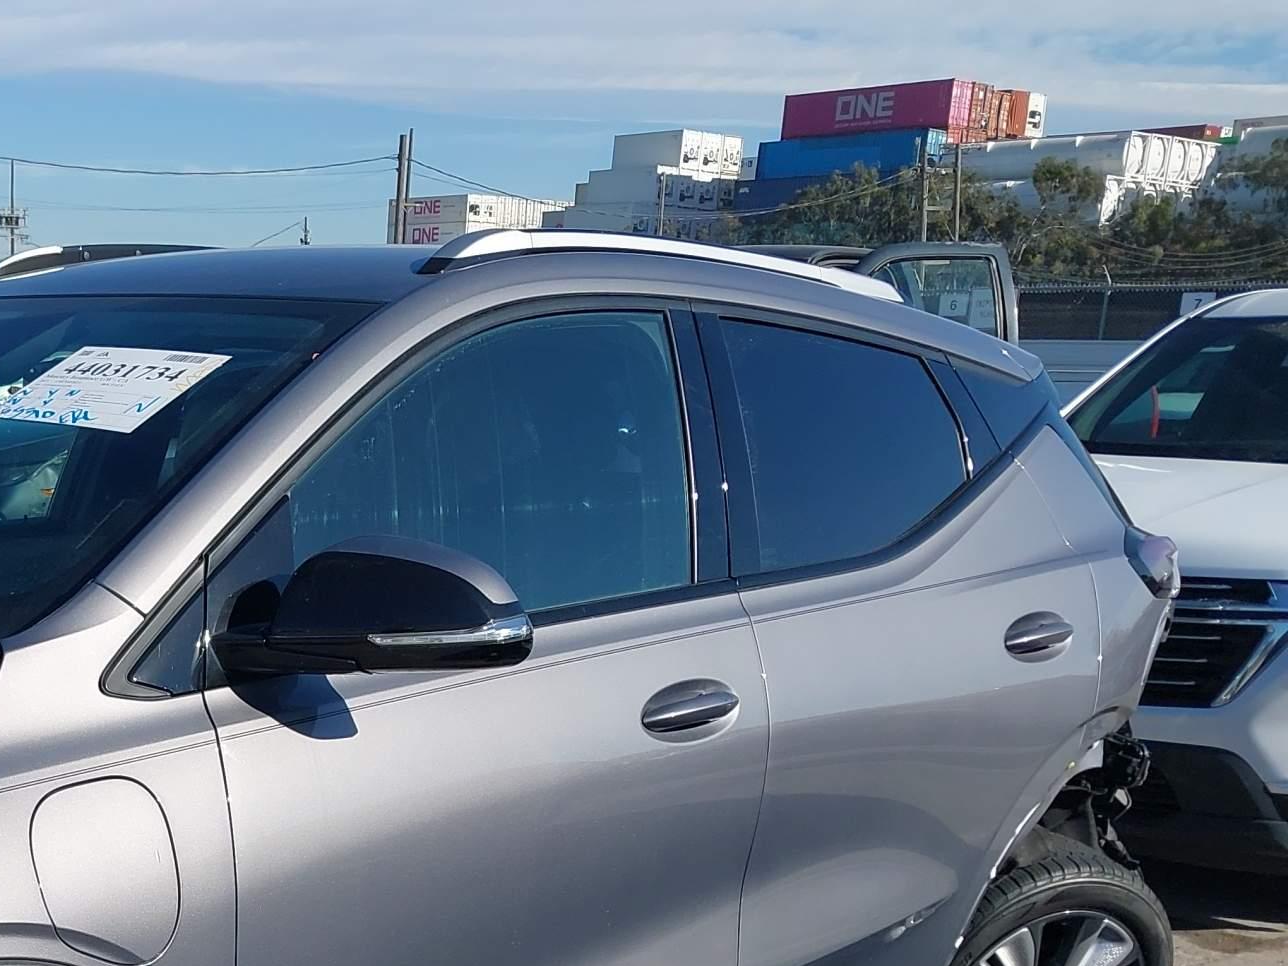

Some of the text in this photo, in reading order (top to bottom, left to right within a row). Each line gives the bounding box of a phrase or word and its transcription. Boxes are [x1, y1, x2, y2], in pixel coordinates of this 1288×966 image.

[835, 92, 895, 120] ONE
[950, 300, 960, 311] 6
[1194, 298, 1203, 310] 7
[64, 362, 188, 382] 44031734
